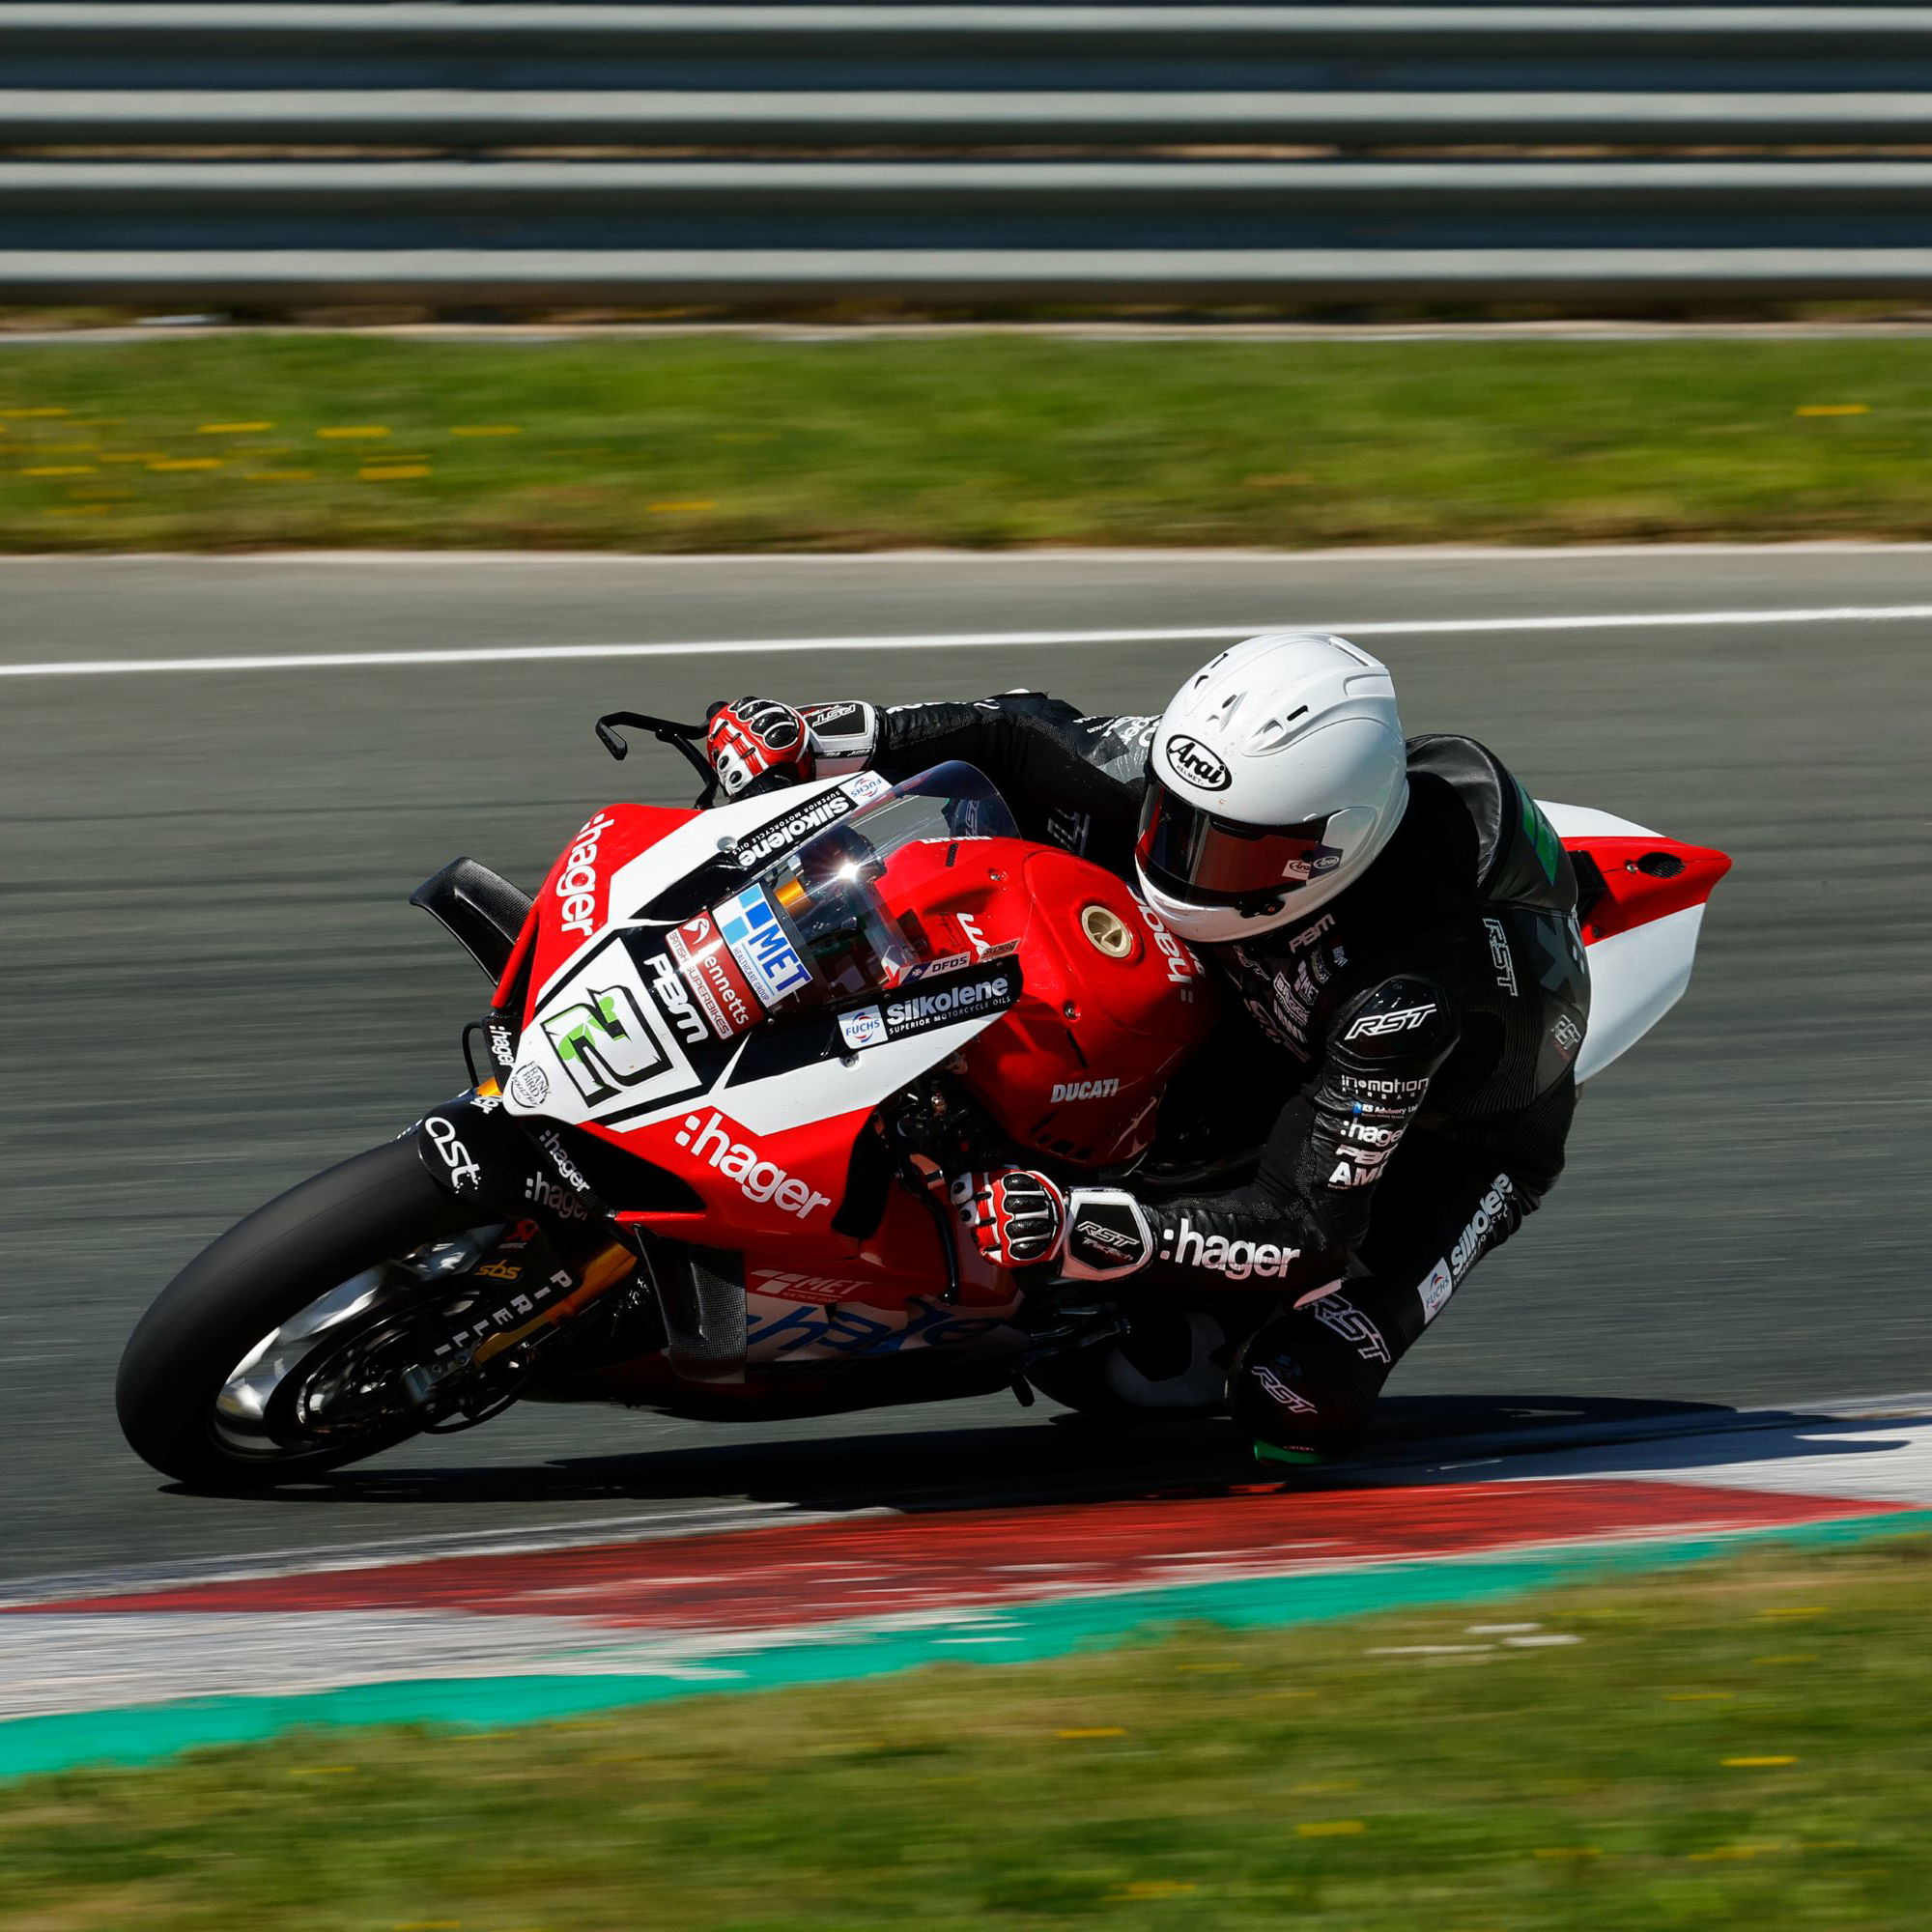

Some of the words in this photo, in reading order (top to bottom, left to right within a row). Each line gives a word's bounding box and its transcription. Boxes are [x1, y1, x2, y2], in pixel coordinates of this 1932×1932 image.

[1168, 742, 1225, 783] Arai
[803, 790, 840, 813] SUPERIOR
[850, 779, 882, 798] FUCHS
[738, 796, 849, 867] Silkolene
[751, 811, 803, 844] MOTORCYCLE
[732, 841, 751, 856] OILS
[732, 947, 757, 984] HEALTHCARE
[753, 979, 771, 1002] GROUP
[749, 923, 810, 992] MET
[932, 955, 968, 973] DFDS
[668, 932, 691, 962] BRITISH
[686, 966, 729, 1036] SUPERBIKES
[697, 947, 750, 1026] ennetts
[886, 977, 1009, 1026] Silkolene
[845, 1019, 881, 1037] FUCHS
[889, 1017, 930, 1035] SUPERIOR
[933, 1002, 989, 1022] MOTORCYCLE
[992, 996, 1011, 1007] OILS
[1345, 1003, 1437, 1041] RST
[540, 984, 674, 1109] 2
[523, 1070, 539, 1097] BIRD
[529, 1061, 552, 1094] FRANK
[1050, 1078, 1120, 1103] DUCATI
[1077, 1220, 1140, 1247] RST
[474, 1260, 523, 1280] sbs
[435, 1269, 574, 1357] PIRELLI
[1251, 1366, 1319, 1414] RST
